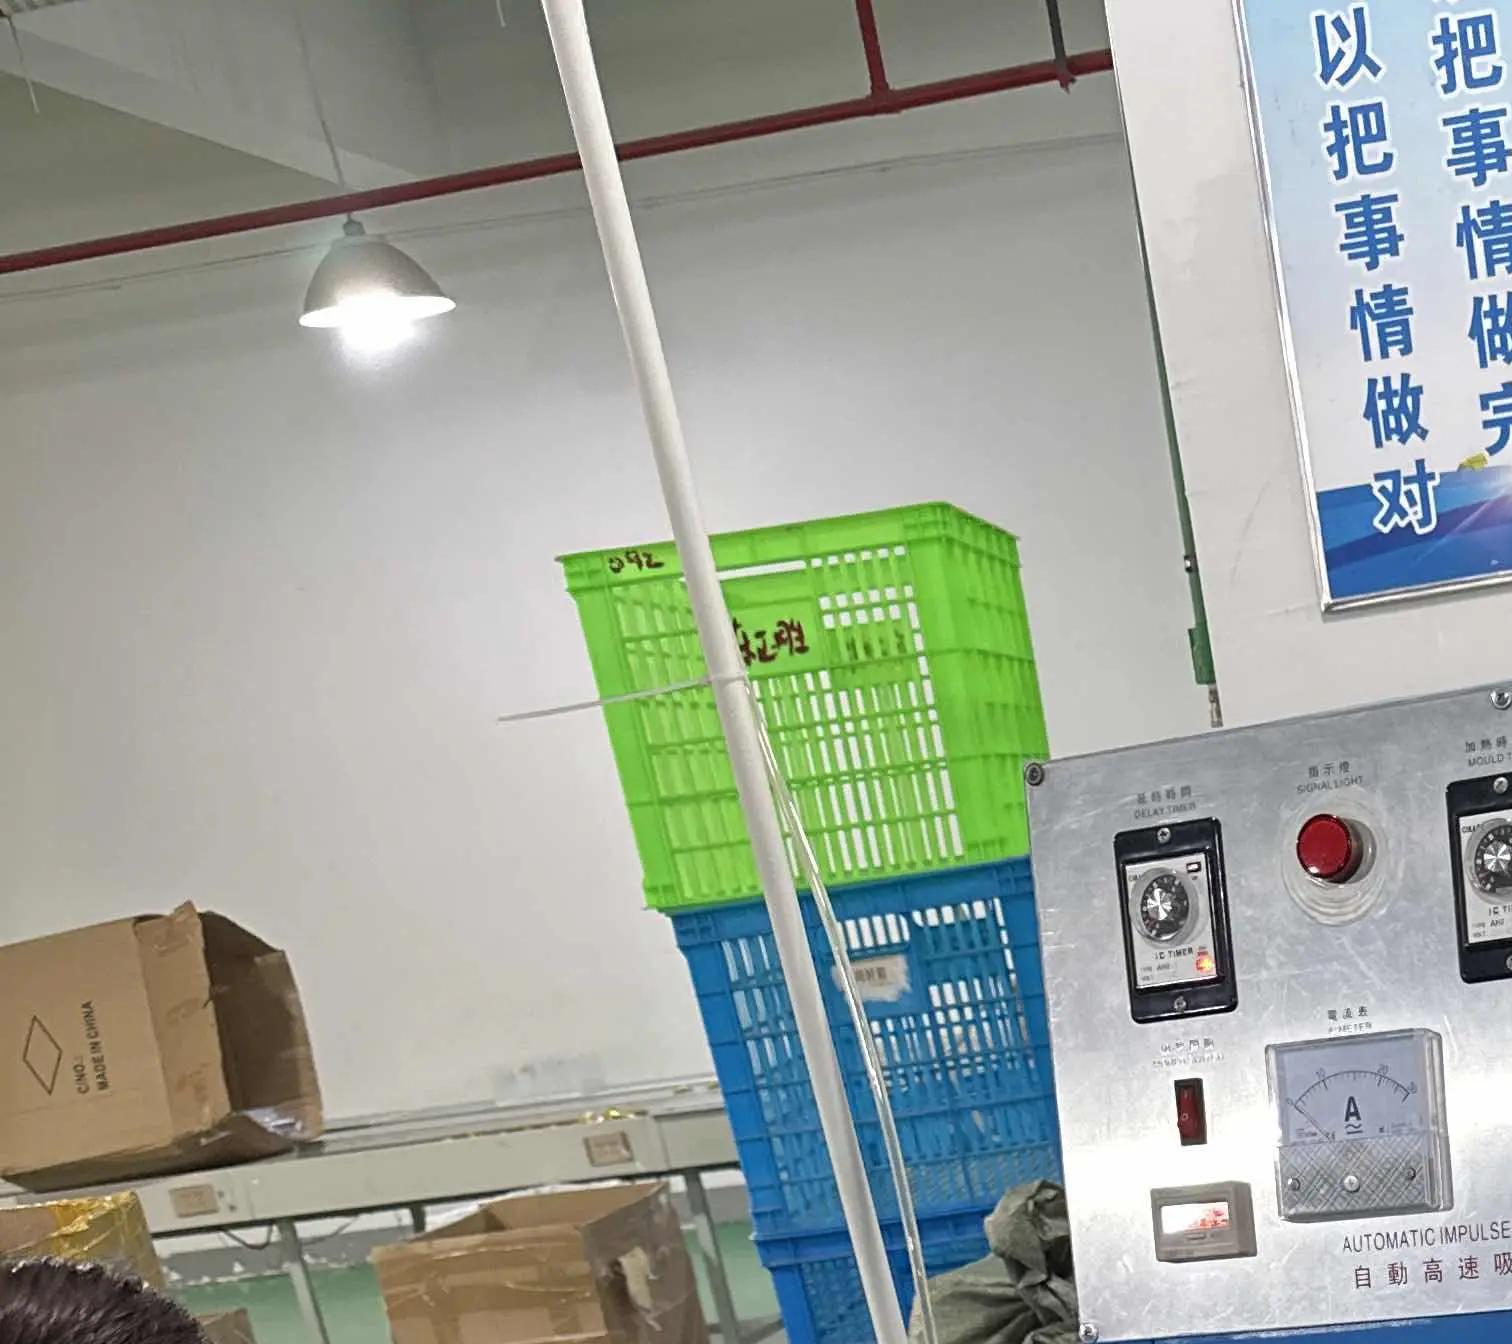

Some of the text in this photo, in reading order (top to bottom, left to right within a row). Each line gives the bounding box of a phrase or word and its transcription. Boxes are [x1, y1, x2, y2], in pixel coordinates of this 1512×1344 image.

[1313, 7, 1438, 534] 以把事情做对
[1468, 753, 1505, 768] MOULD
[1296, 775, 1364, 795] SIGNAL LIGHT
[1134, 802, 1197, 820] DELAY TIMER
[1489, 906, 1499, 916] IC
[1155, 946, 1194, 960] IC TIMER
[81, 1000, 109, 1091] MADE IN CHINA
[1344, 1096, 1362, 1123] A
[1342, 1227, 1436, 1254] AUTOMATIC
[1439, 1220, 1511, 1245] IMPULSE
